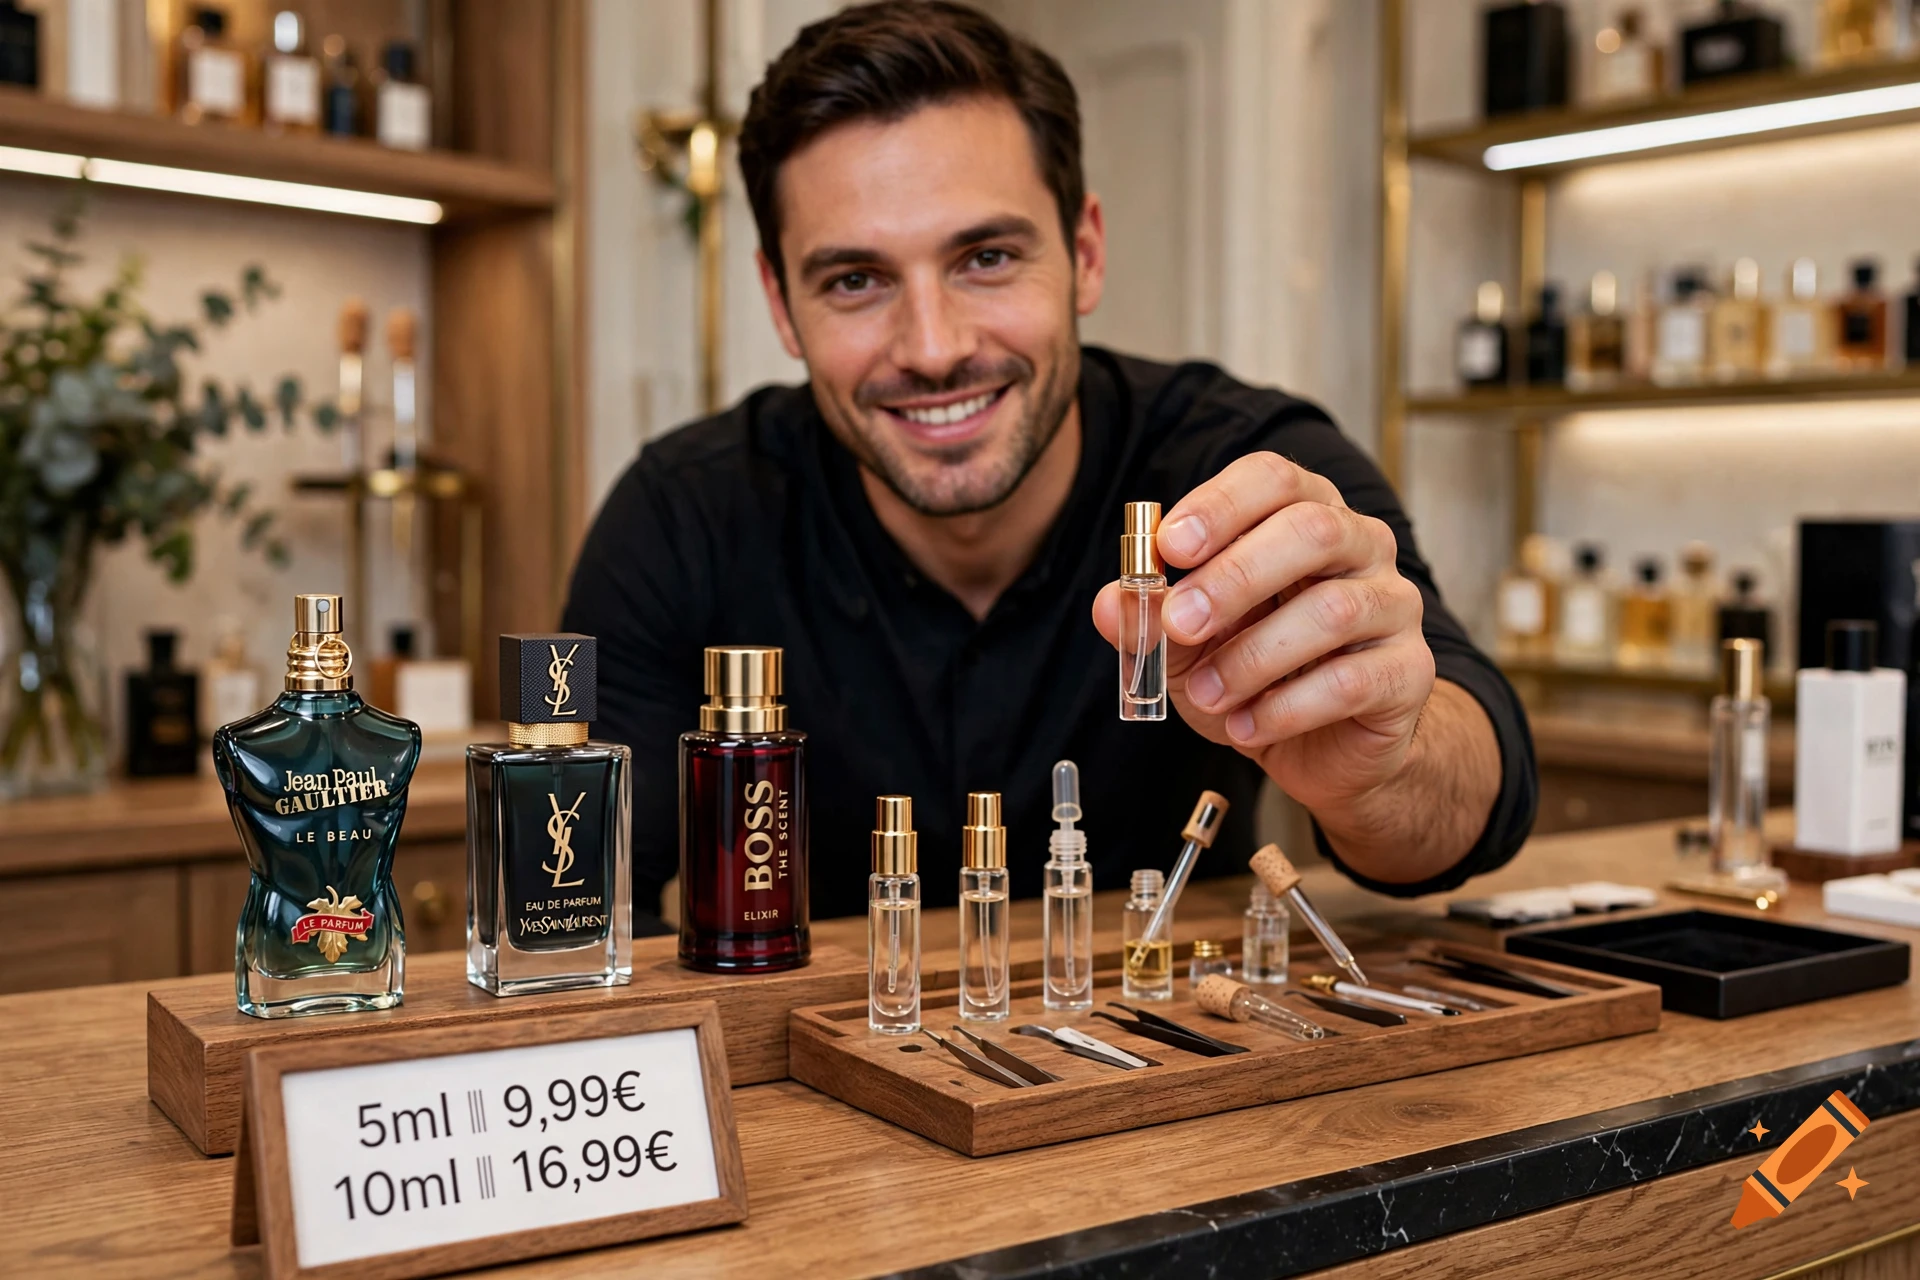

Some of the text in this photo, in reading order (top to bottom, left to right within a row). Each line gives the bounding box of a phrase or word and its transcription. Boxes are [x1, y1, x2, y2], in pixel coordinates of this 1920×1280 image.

[283, 766, 379, 792] Jean Paul
[275, 779, 390, 815] GAULTIER
[296, 829, 372, 843] LE BEAU
[744, 780, 774, 891] BOSS
[778, 789, 788, 879] THE SCENT
[525, 896, 602, 911] EAU DE PARFUM
[744, 909, 779, 921] ELIXIR
[302, 919, 364, 931] LE PARFUM
[358, 1070, 646, 1148] 5ml 9,99€
[334, 1130, 678, 1220] 10ml 16,99€
